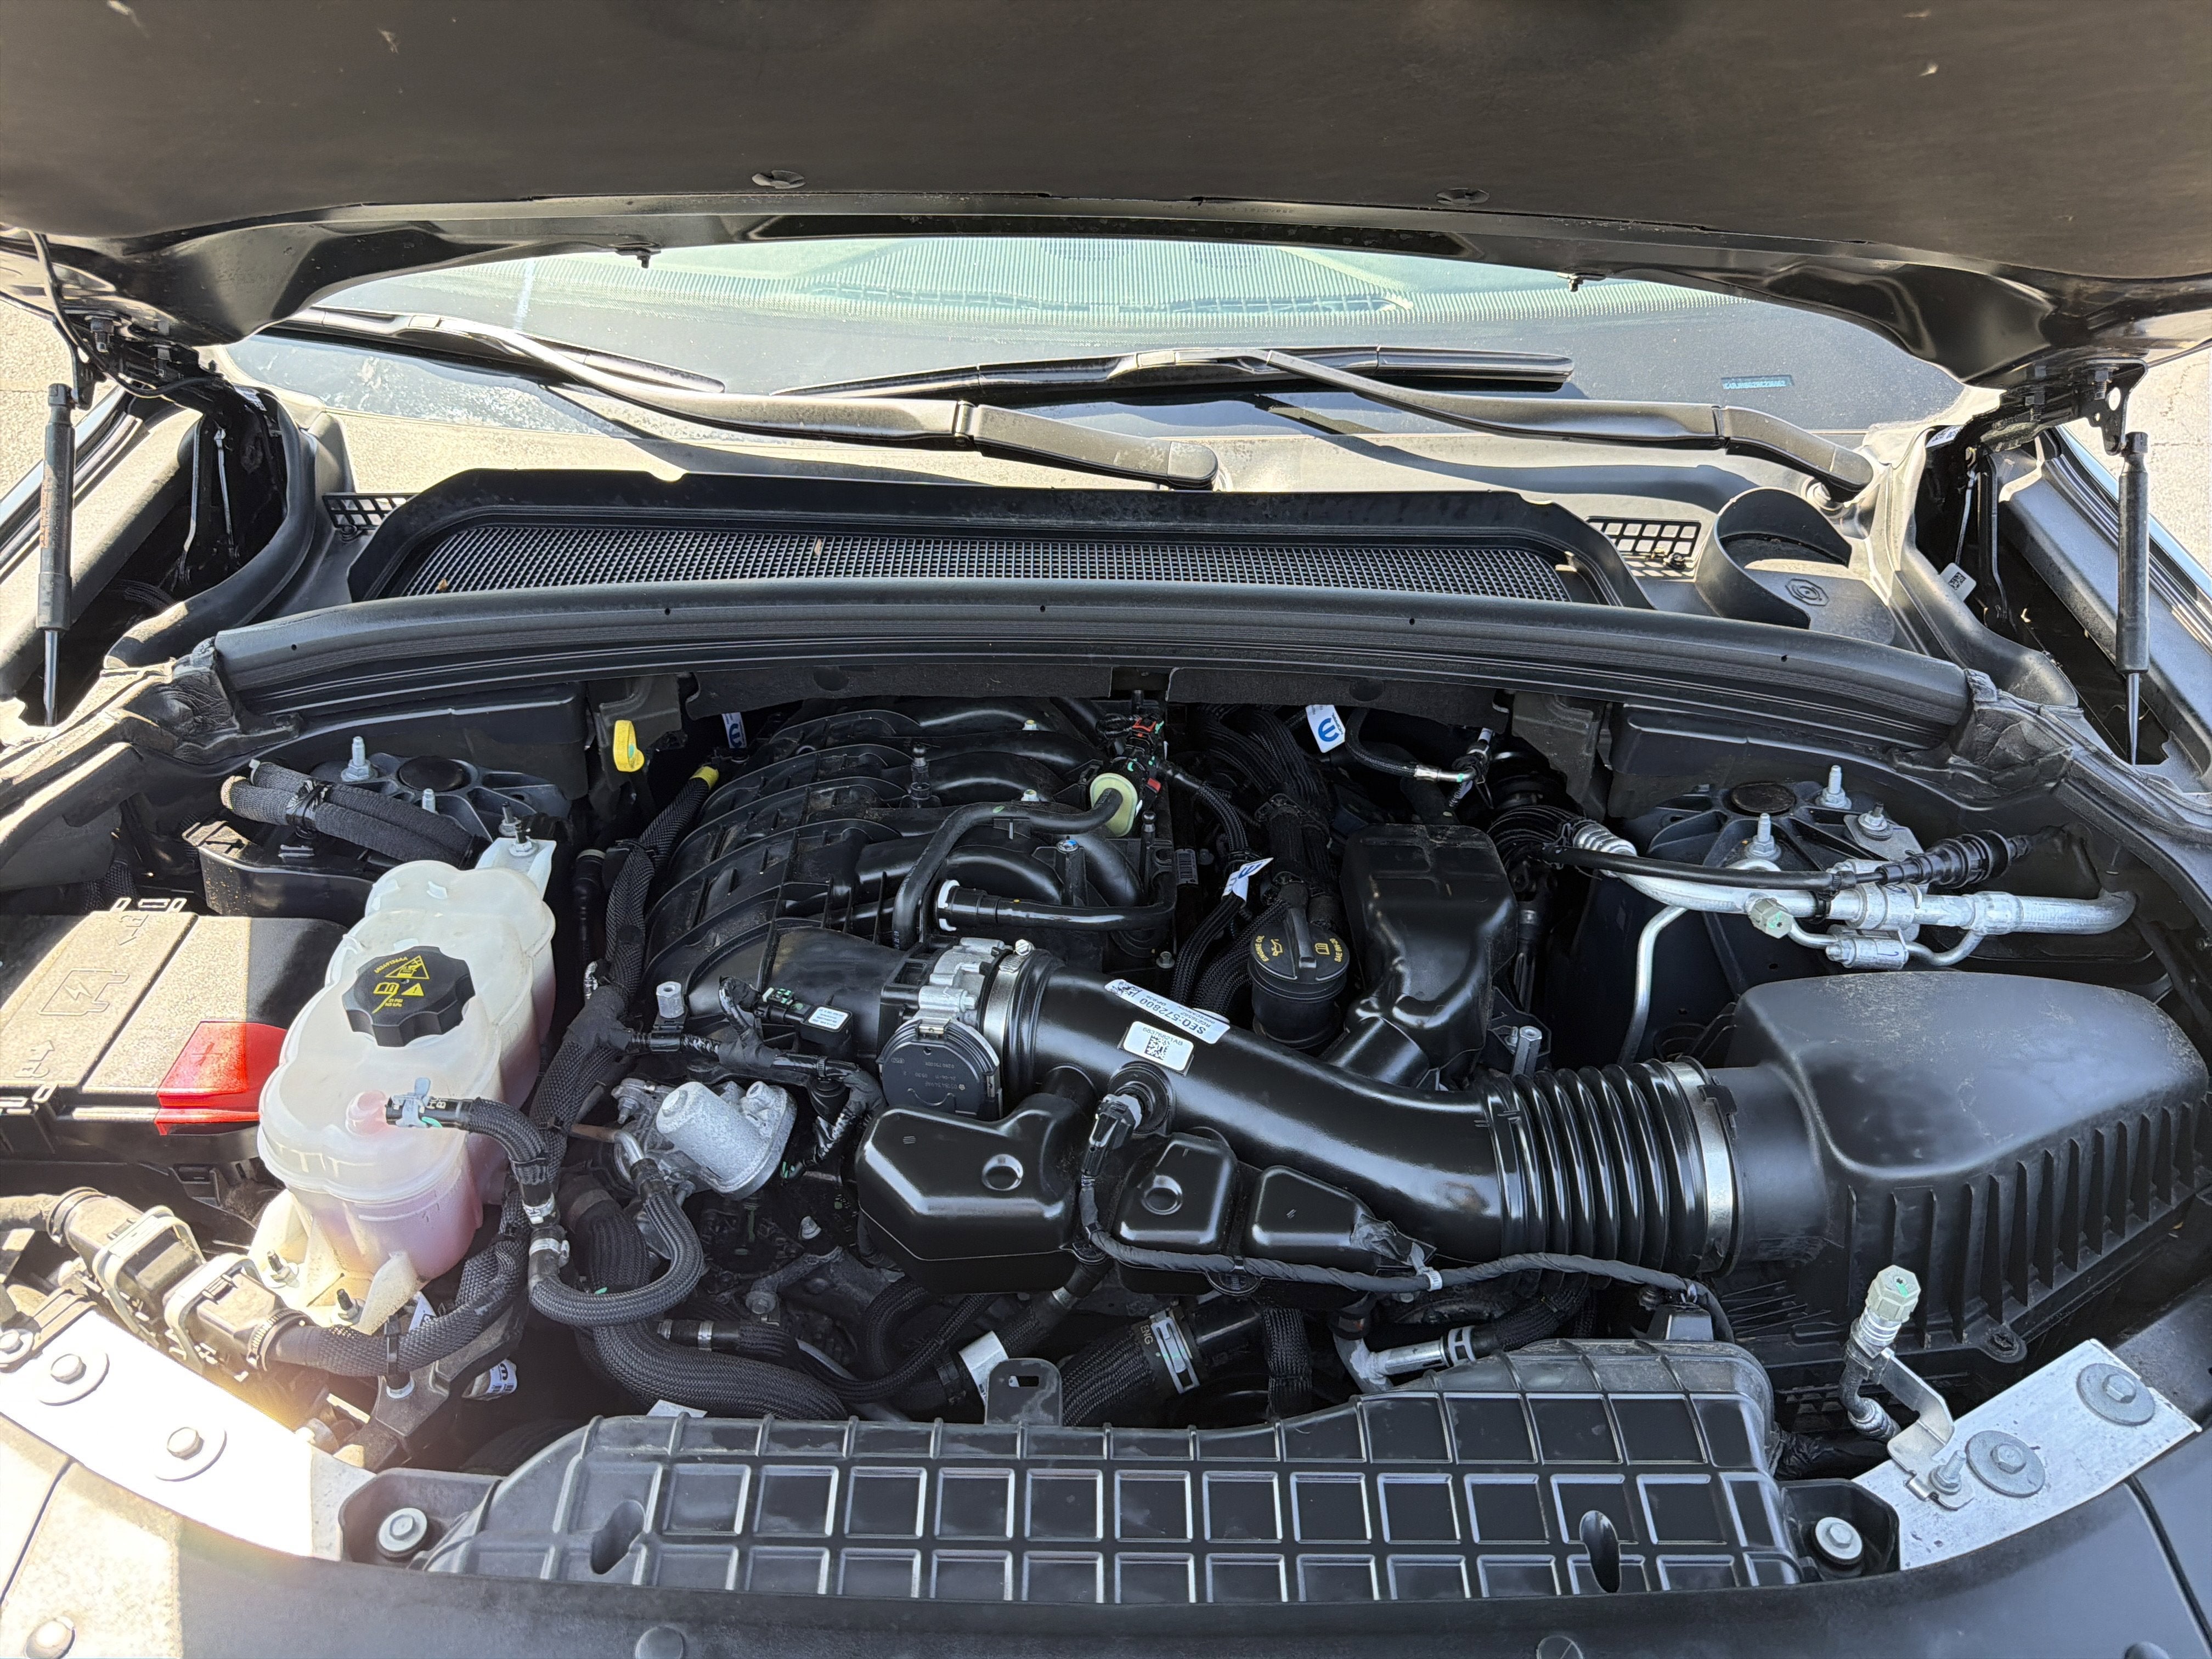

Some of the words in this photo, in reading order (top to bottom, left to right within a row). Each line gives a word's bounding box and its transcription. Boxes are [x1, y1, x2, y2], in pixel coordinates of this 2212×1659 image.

[1255, 943, 1269, 962] ENGINE
[1329, 938, 1342, 952] 0W-20
[1334, 952, 1343, 962] SAE
[1139, 997, 1206, 1035] SEQ:572800
[1140, 1324, 1154, 1345] ENG
